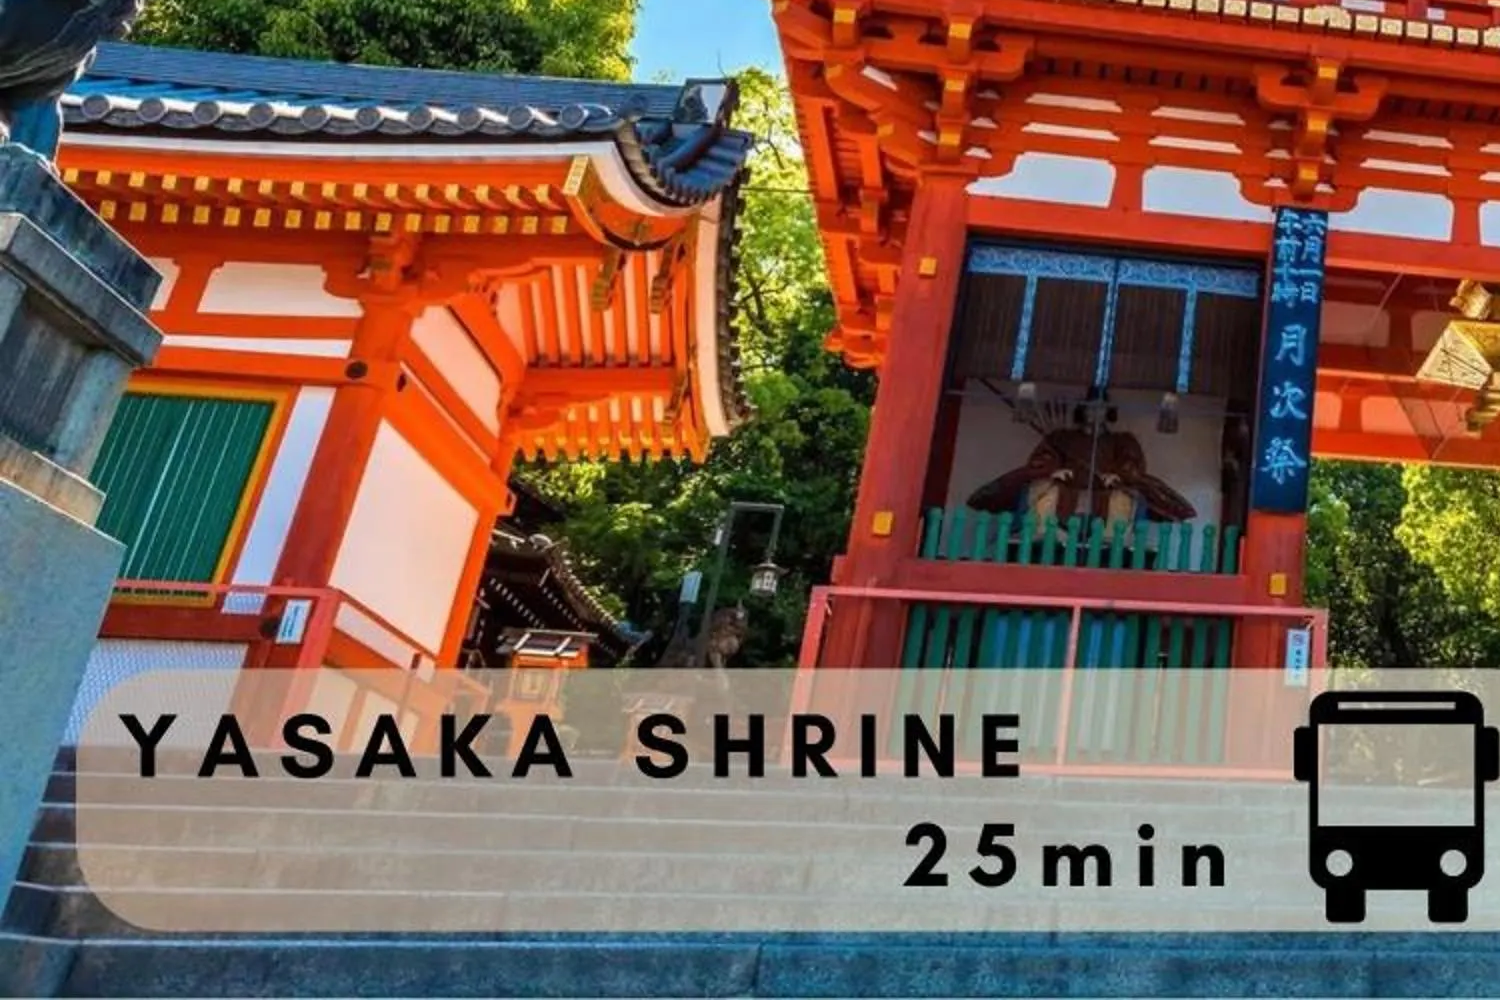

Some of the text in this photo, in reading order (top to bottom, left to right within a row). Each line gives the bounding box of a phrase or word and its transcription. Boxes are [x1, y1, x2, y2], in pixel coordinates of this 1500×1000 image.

[1270, 208, 1303, 308] 午前十時
[1300, 212, 1327, 304] 六月一日
[1260, 323, 1308, 485] 月次祭
